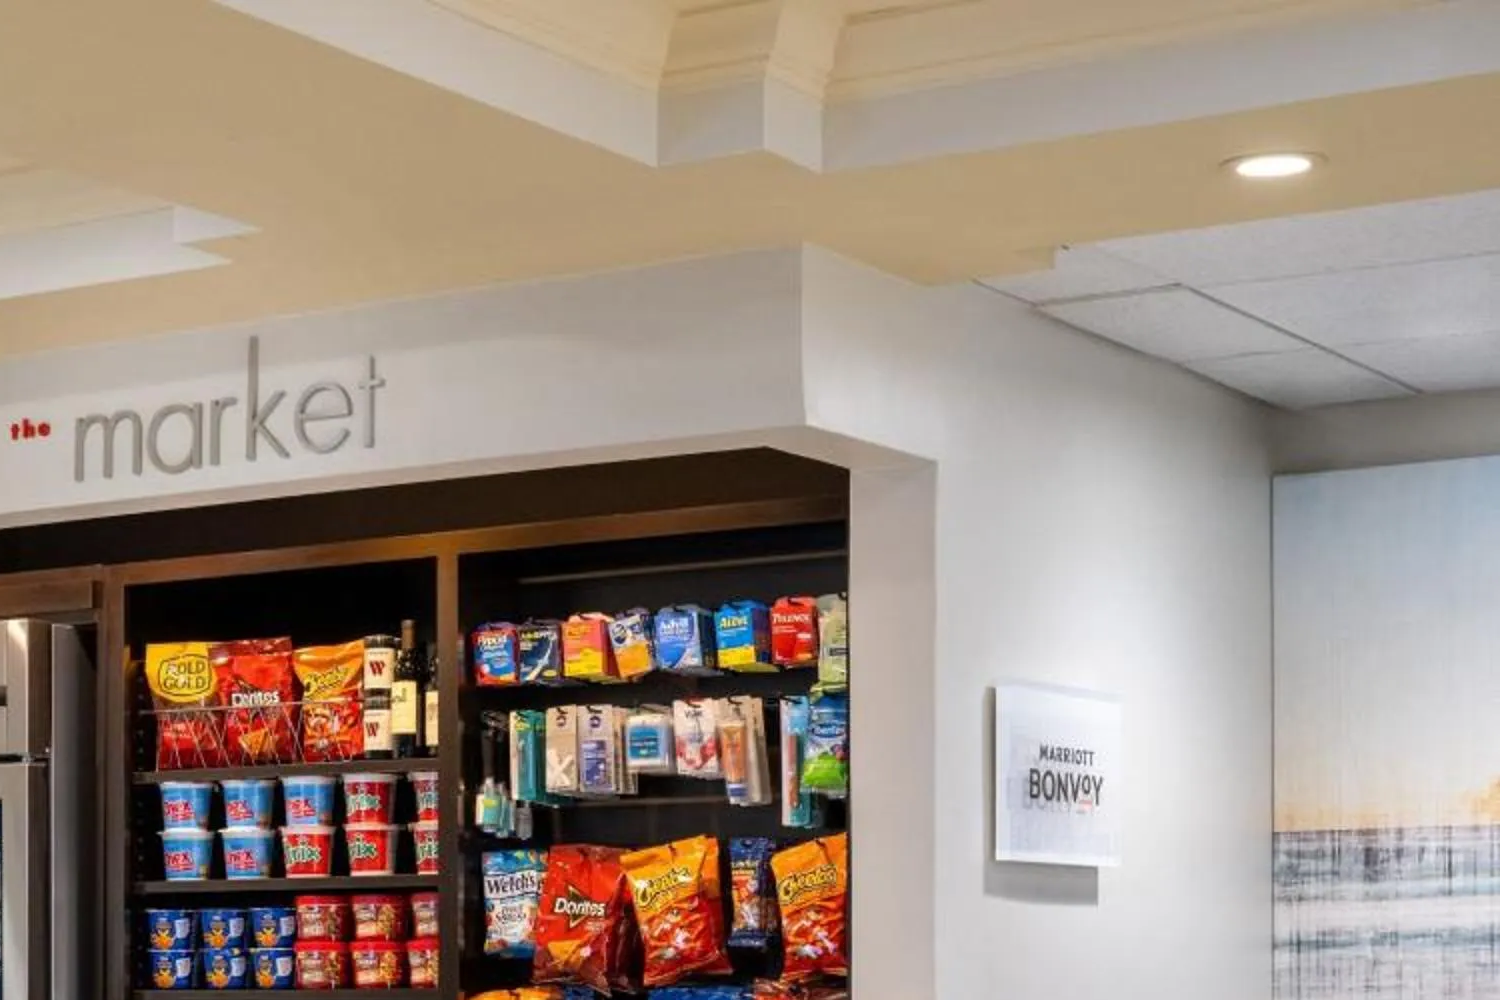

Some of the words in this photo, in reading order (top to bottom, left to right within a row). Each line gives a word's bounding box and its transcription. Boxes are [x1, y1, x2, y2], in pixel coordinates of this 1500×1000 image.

[8, 417, 52, 441] the
[74, 335, 387, 483] market
[166, 661, 206, 675] ROLD
[370, 660, 386, 677] W
[164, 676, 205, 690] GOLD
[1039, 744, 1095, 766] MARRIOTT
[1029, 768, 1104, 806] BONVOY
[487, 874, 535, 894] Welch's
[555, 898, 605, 916] Doritos
